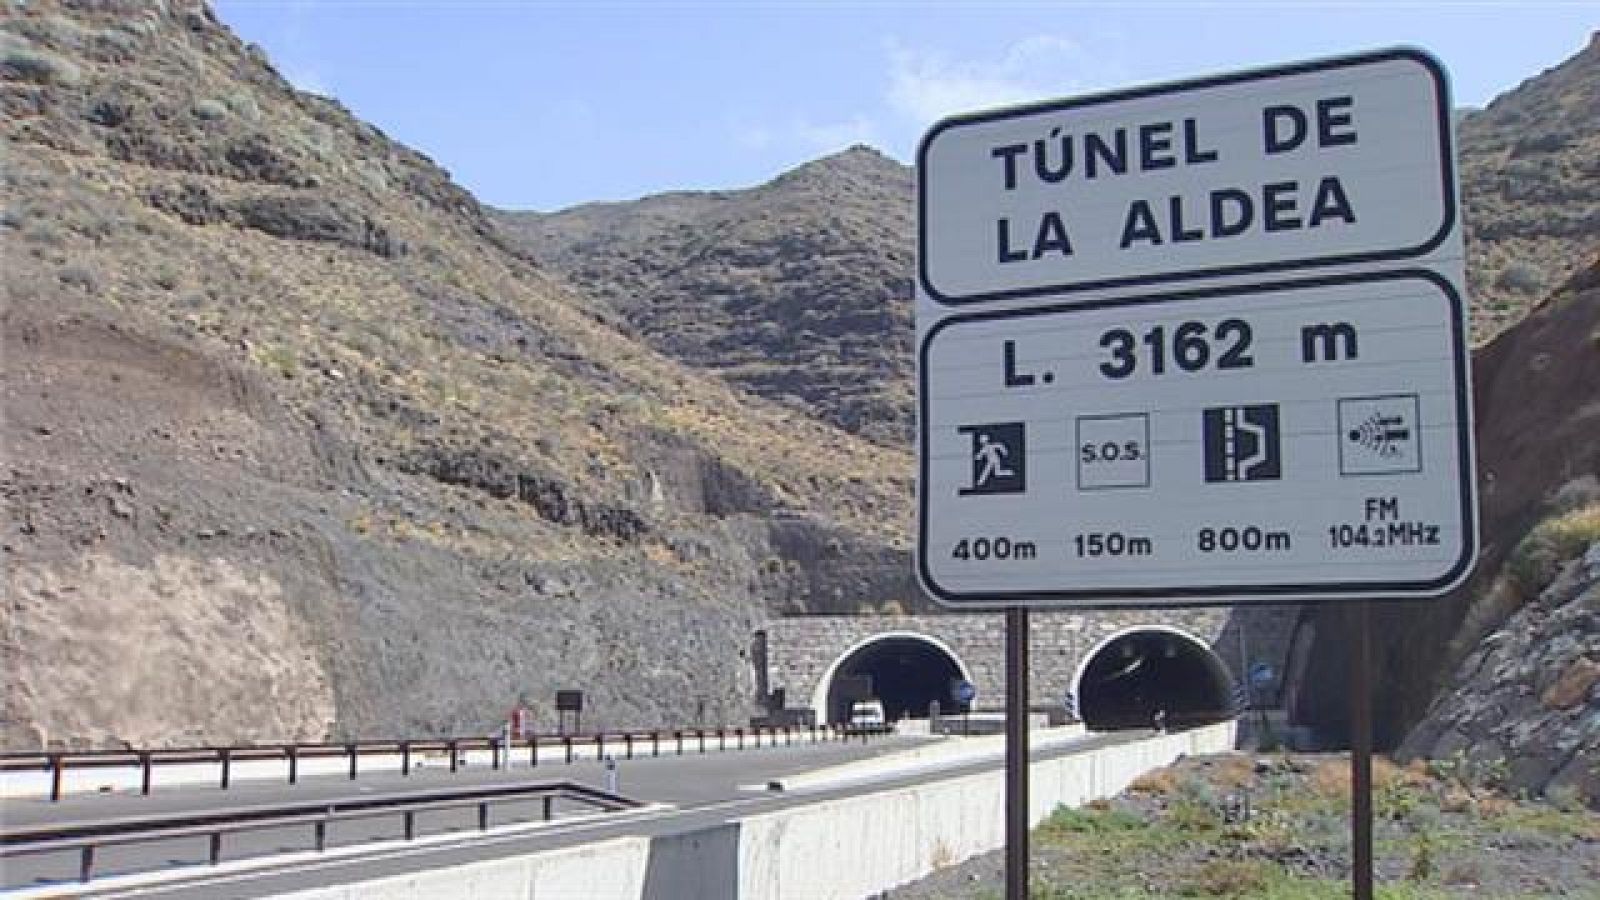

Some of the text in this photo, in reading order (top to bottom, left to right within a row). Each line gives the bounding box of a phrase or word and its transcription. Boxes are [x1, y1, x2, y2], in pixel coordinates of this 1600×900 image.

[991, 96, 1358, 191] TÚNEL DE
[997, 176, 1357, 263] LA ALDEA
[1004, 319, 1358, 388] L. 3162 m
[1364, 497, 1399, 521] FM
[952, 536, 1037, 561] 400m
[1075, 532, 1153, 557] 150m
[1198, 526, 1291, 552] 800m
